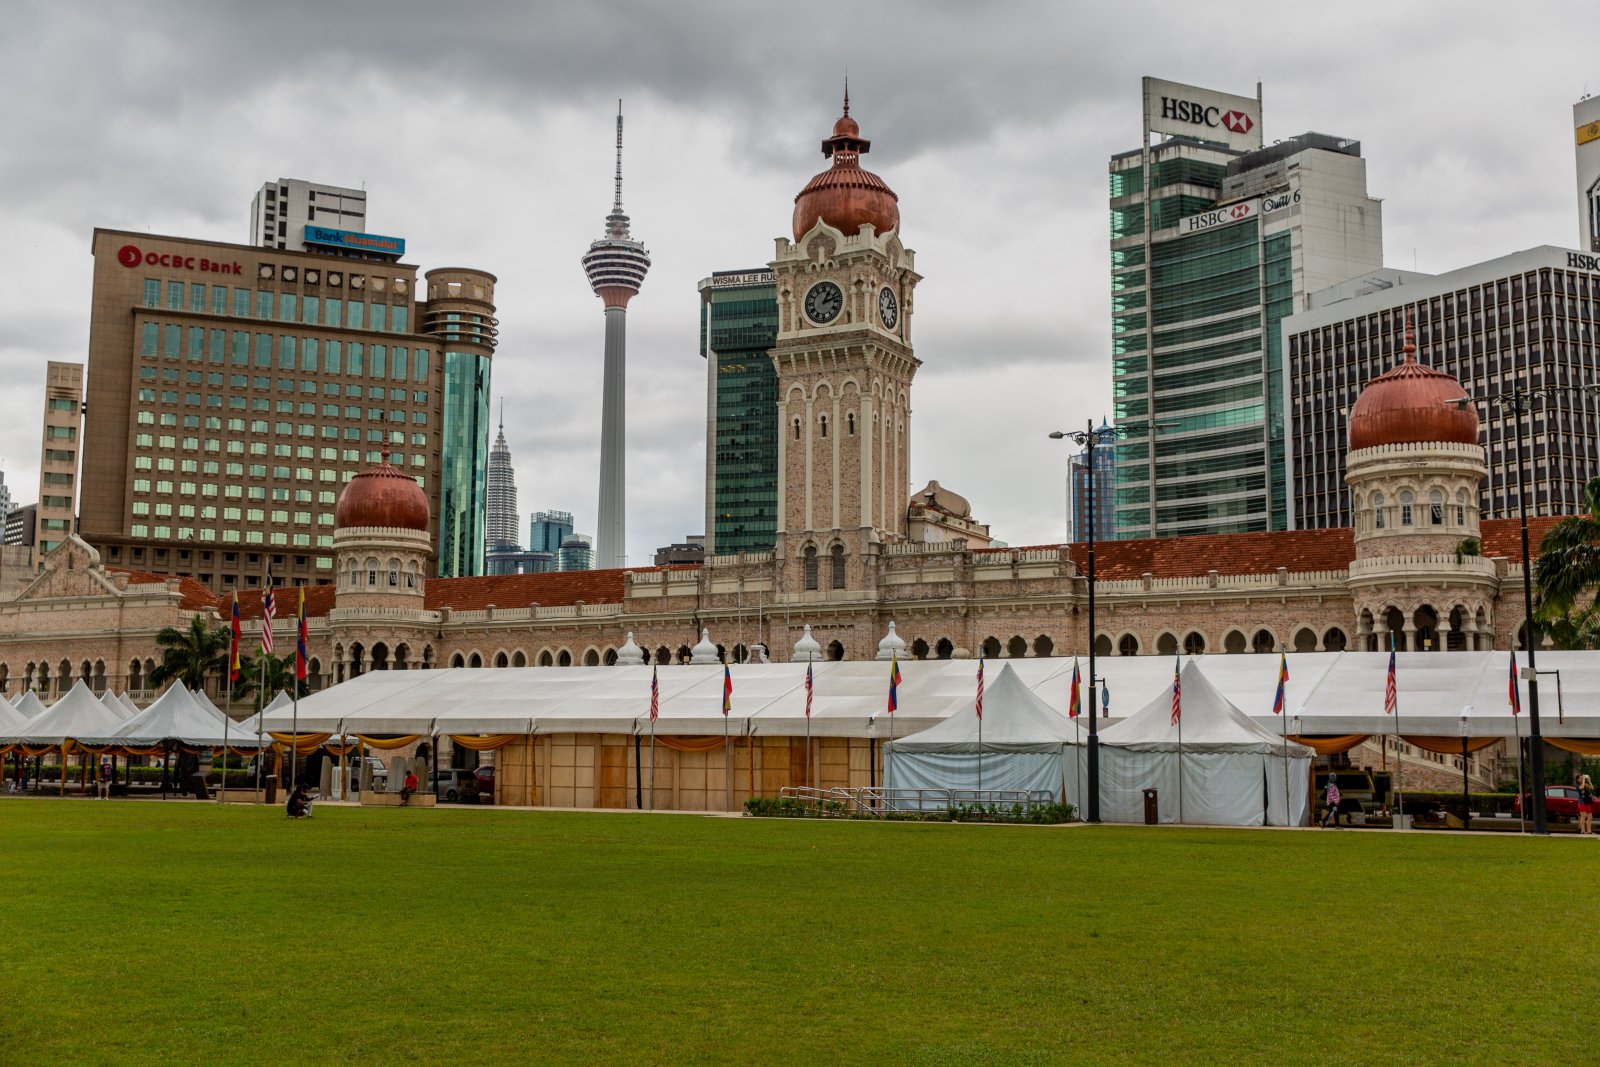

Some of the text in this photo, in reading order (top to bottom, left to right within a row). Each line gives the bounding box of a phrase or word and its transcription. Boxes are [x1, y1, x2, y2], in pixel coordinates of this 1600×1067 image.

[1161, 96, 1219, 128] HSBC
[1293, 188, 1301, 203] 6
[1189, 209, 1227, 231] HSBC
[315, 229, 397, 249] Bank Muamalat
[145, 252, 242, 275] OCBC Bank
[713, 276, 741, 285] WISMA
[743, 274, 759, 283] LEE
